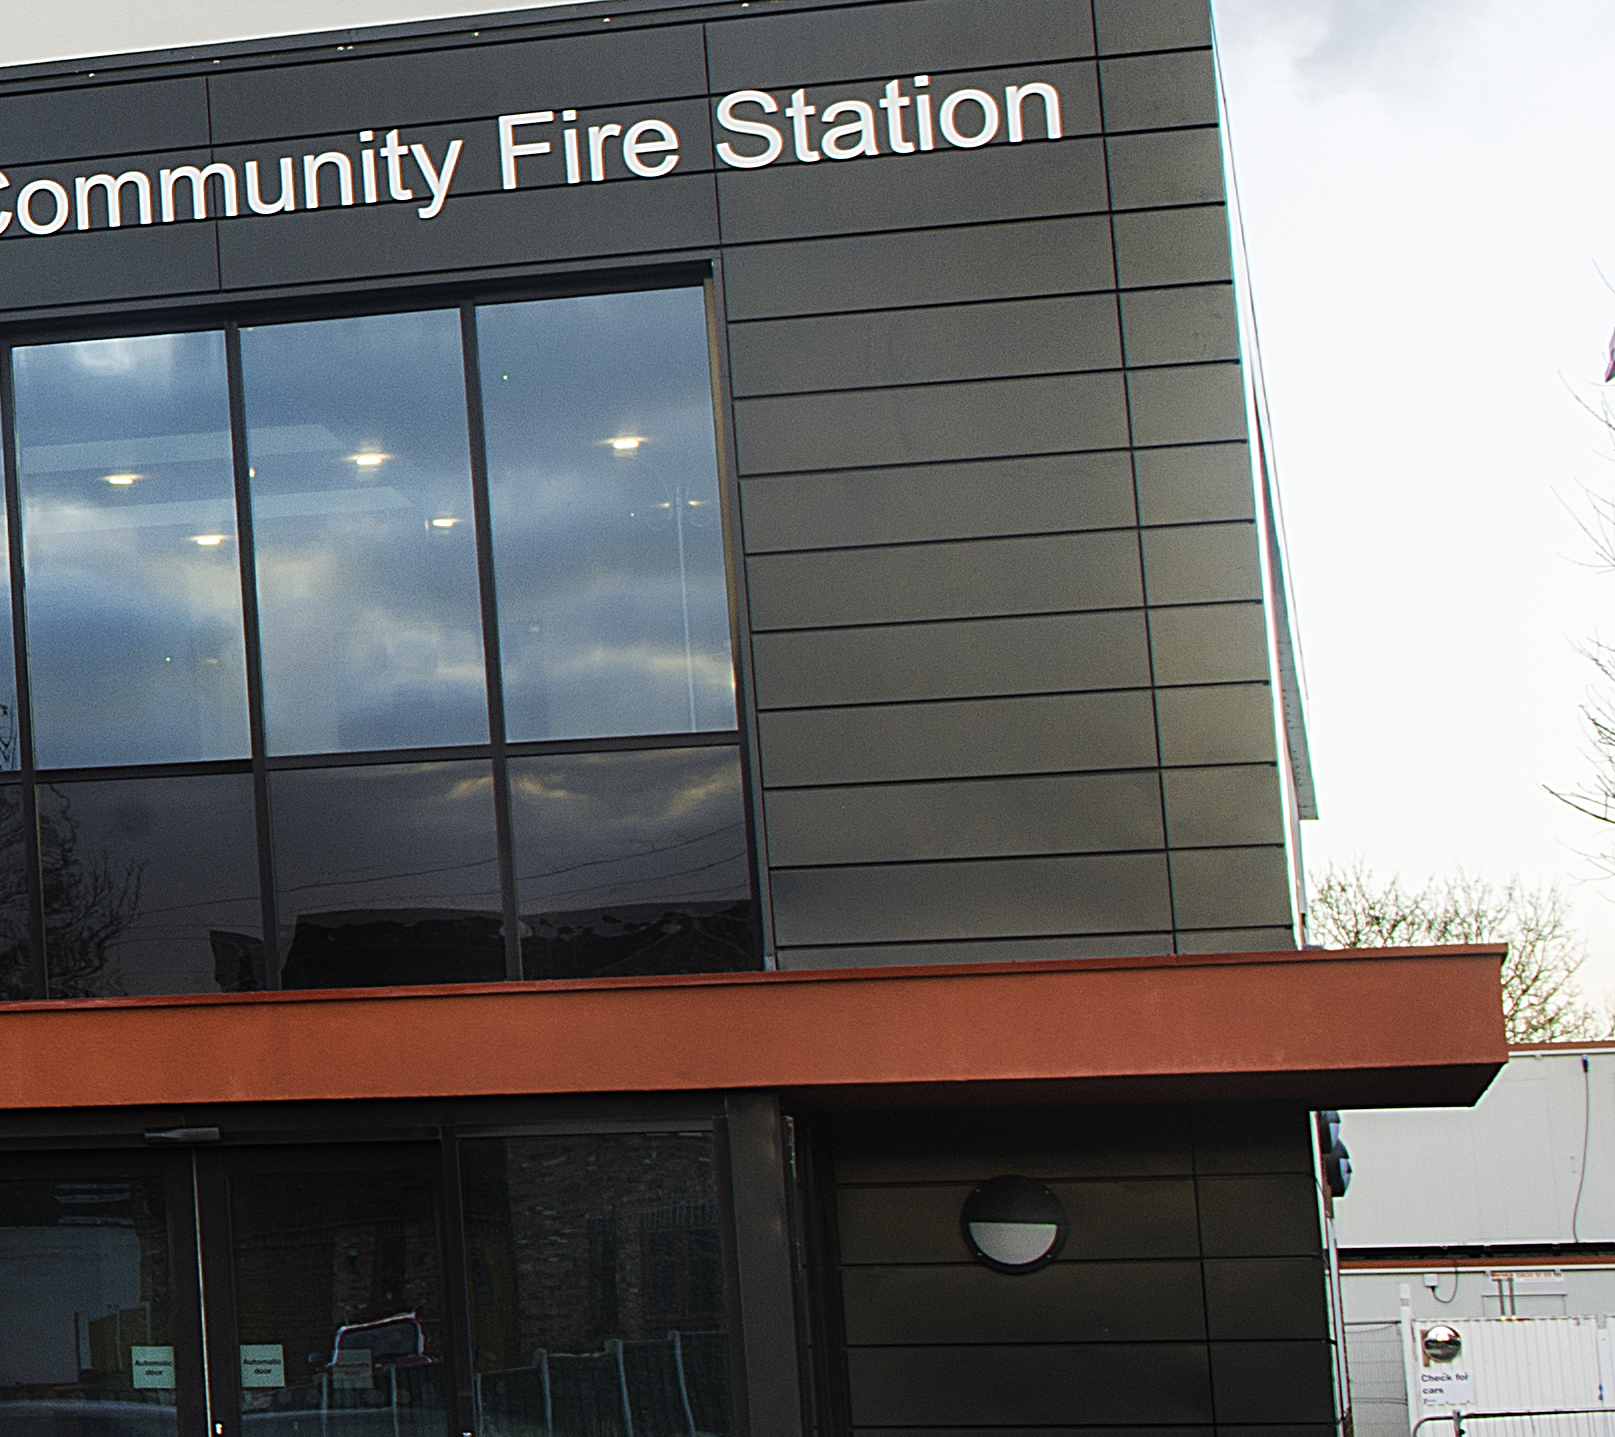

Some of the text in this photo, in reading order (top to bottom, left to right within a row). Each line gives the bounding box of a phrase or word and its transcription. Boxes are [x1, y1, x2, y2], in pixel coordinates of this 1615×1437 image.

[498, 107, 680, 190] Fire
[715, 73, 1063, 169] Station
[1420, 1371, 1470, 1382] Check for
